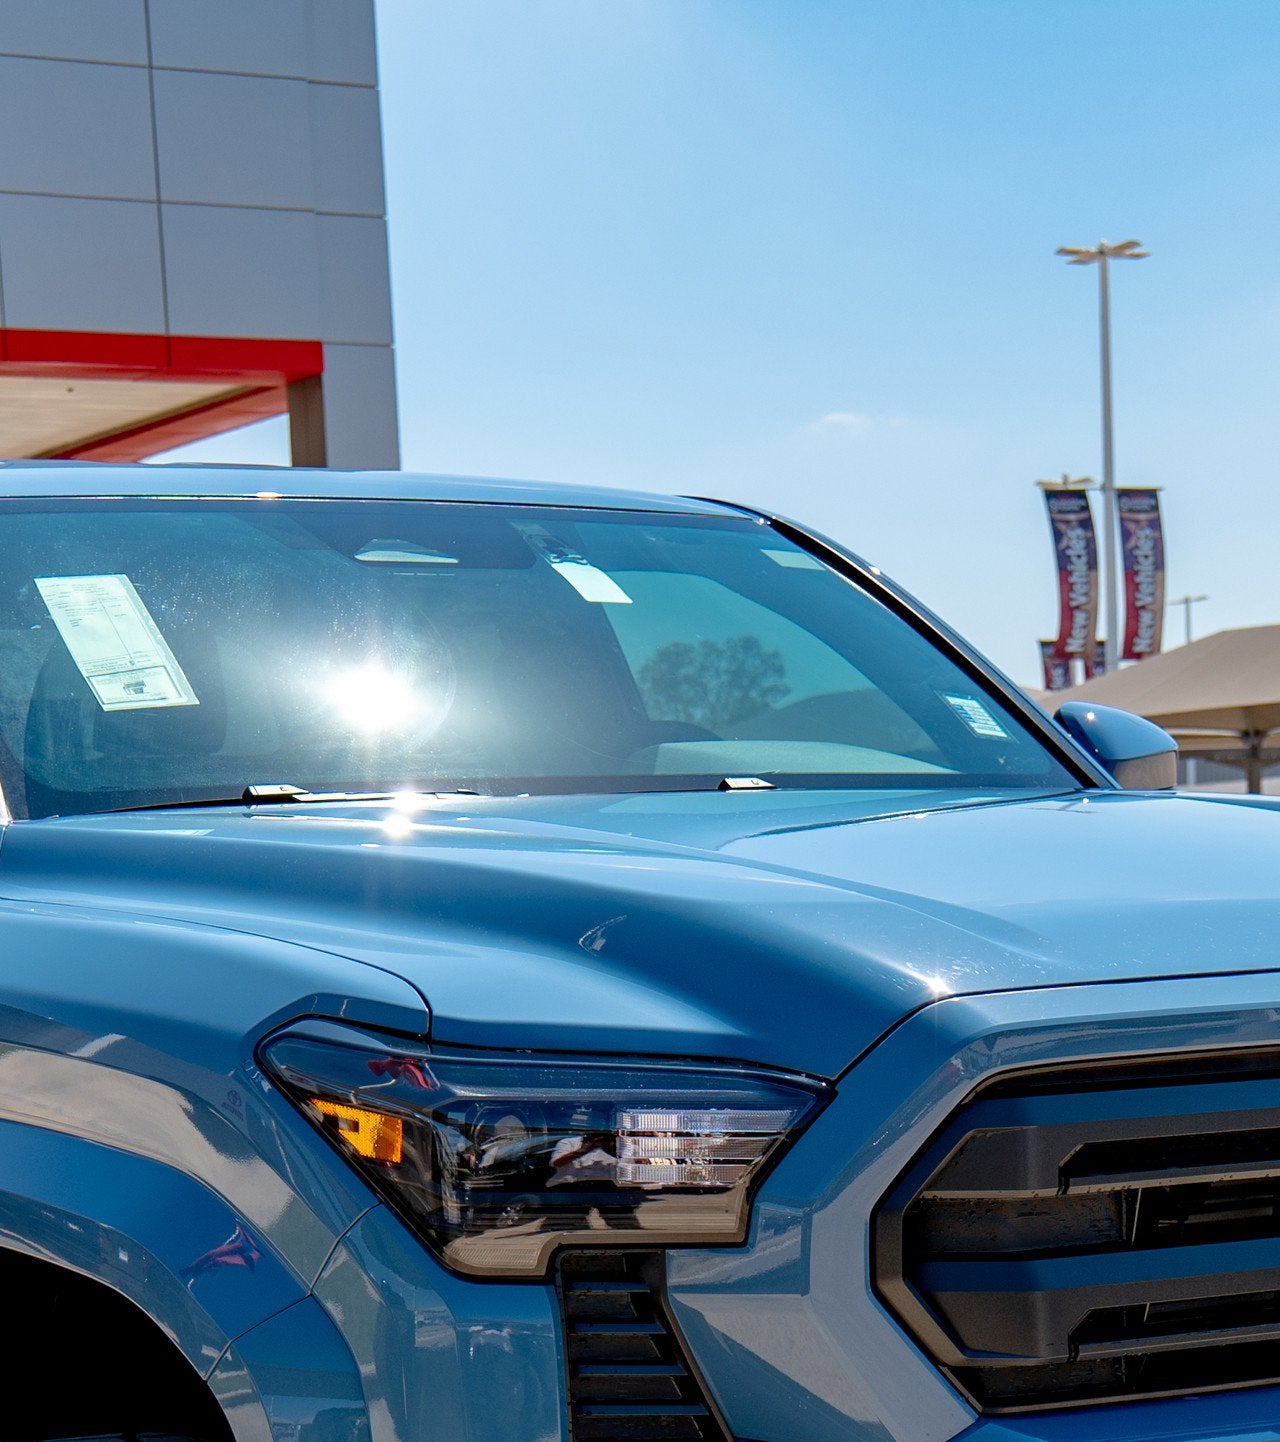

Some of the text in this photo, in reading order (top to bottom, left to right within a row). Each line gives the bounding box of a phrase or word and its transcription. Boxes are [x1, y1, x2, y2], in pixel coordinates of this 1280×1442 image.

[1065, 527, 1090, 607] Vehicles
[1133, 527, 1155, 607] Vehicles
[1065, 609, 1089, 652] New
[1133, 609, 1155, 652] New
